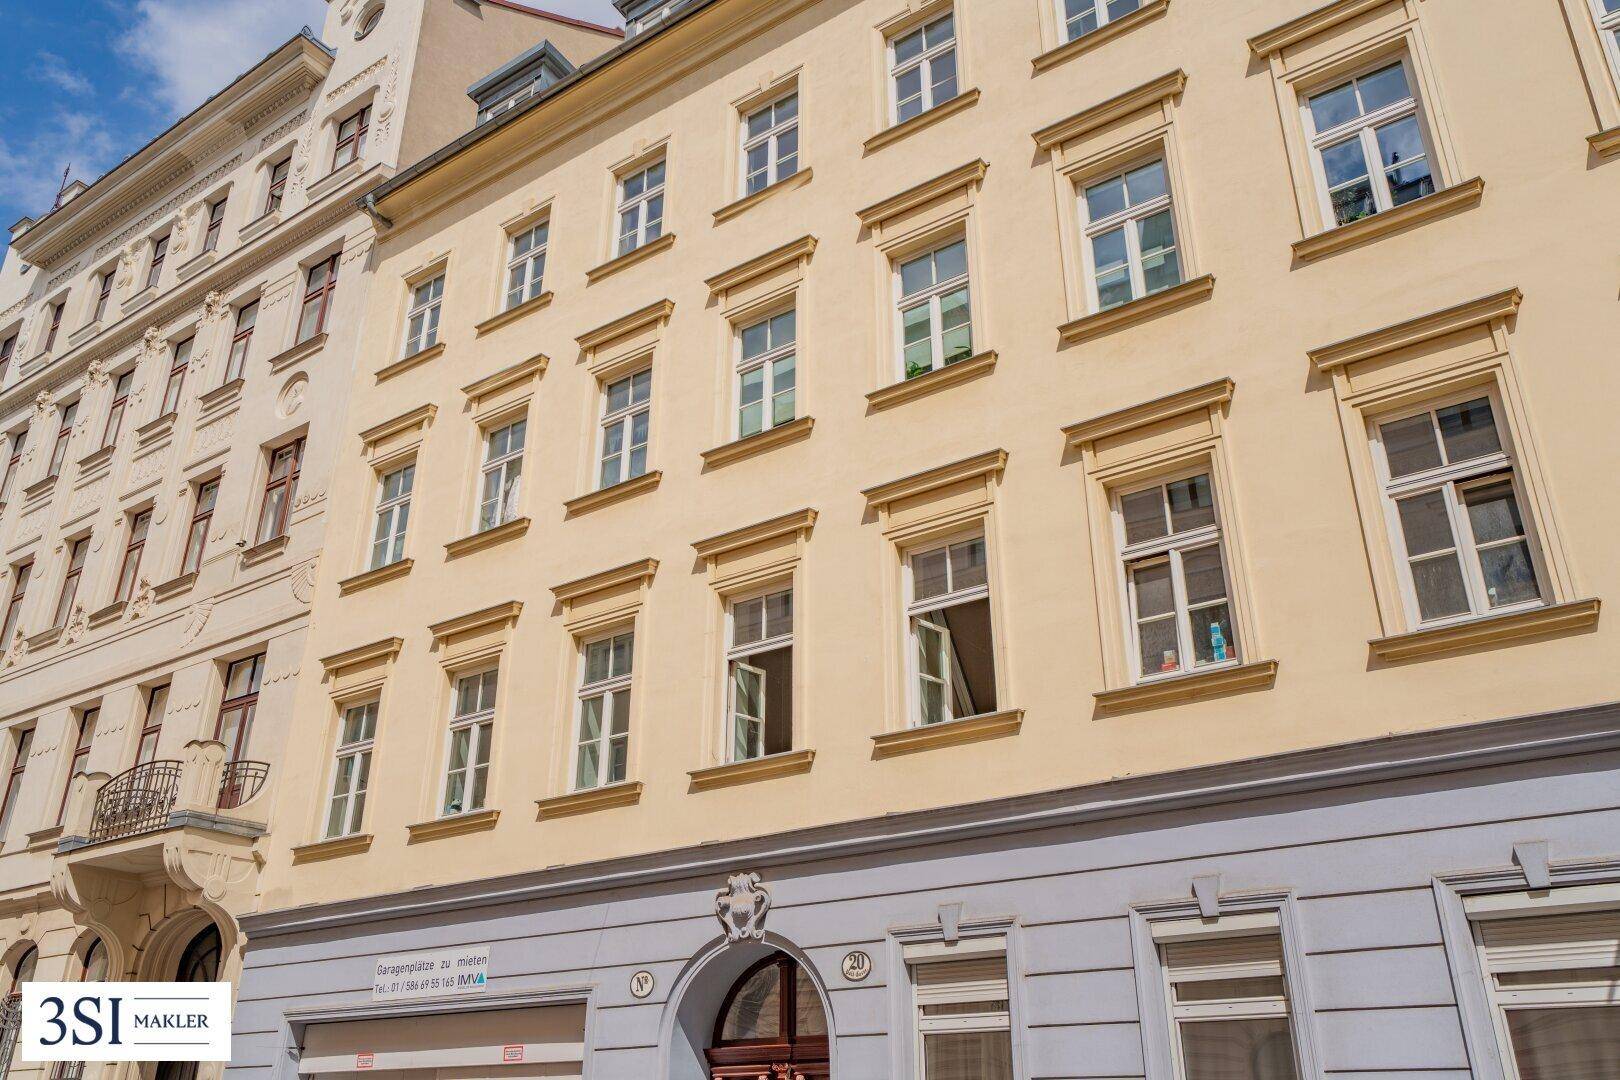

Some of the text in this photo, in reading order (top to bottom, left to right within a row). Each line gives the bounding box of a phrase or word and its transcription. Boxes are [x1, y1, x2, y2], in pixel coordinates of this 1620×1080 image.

[376, 955, 487, 977] Garagenplätze zu mieten
[849, 953, 865, 970] 20
[391, 982, 400, 992] 01
[406, 980, 419, 991] 586
[420, 979, 430, 990] 69
[430, 978, 440, 989] 55
[441, 976, 455, 988] 165
